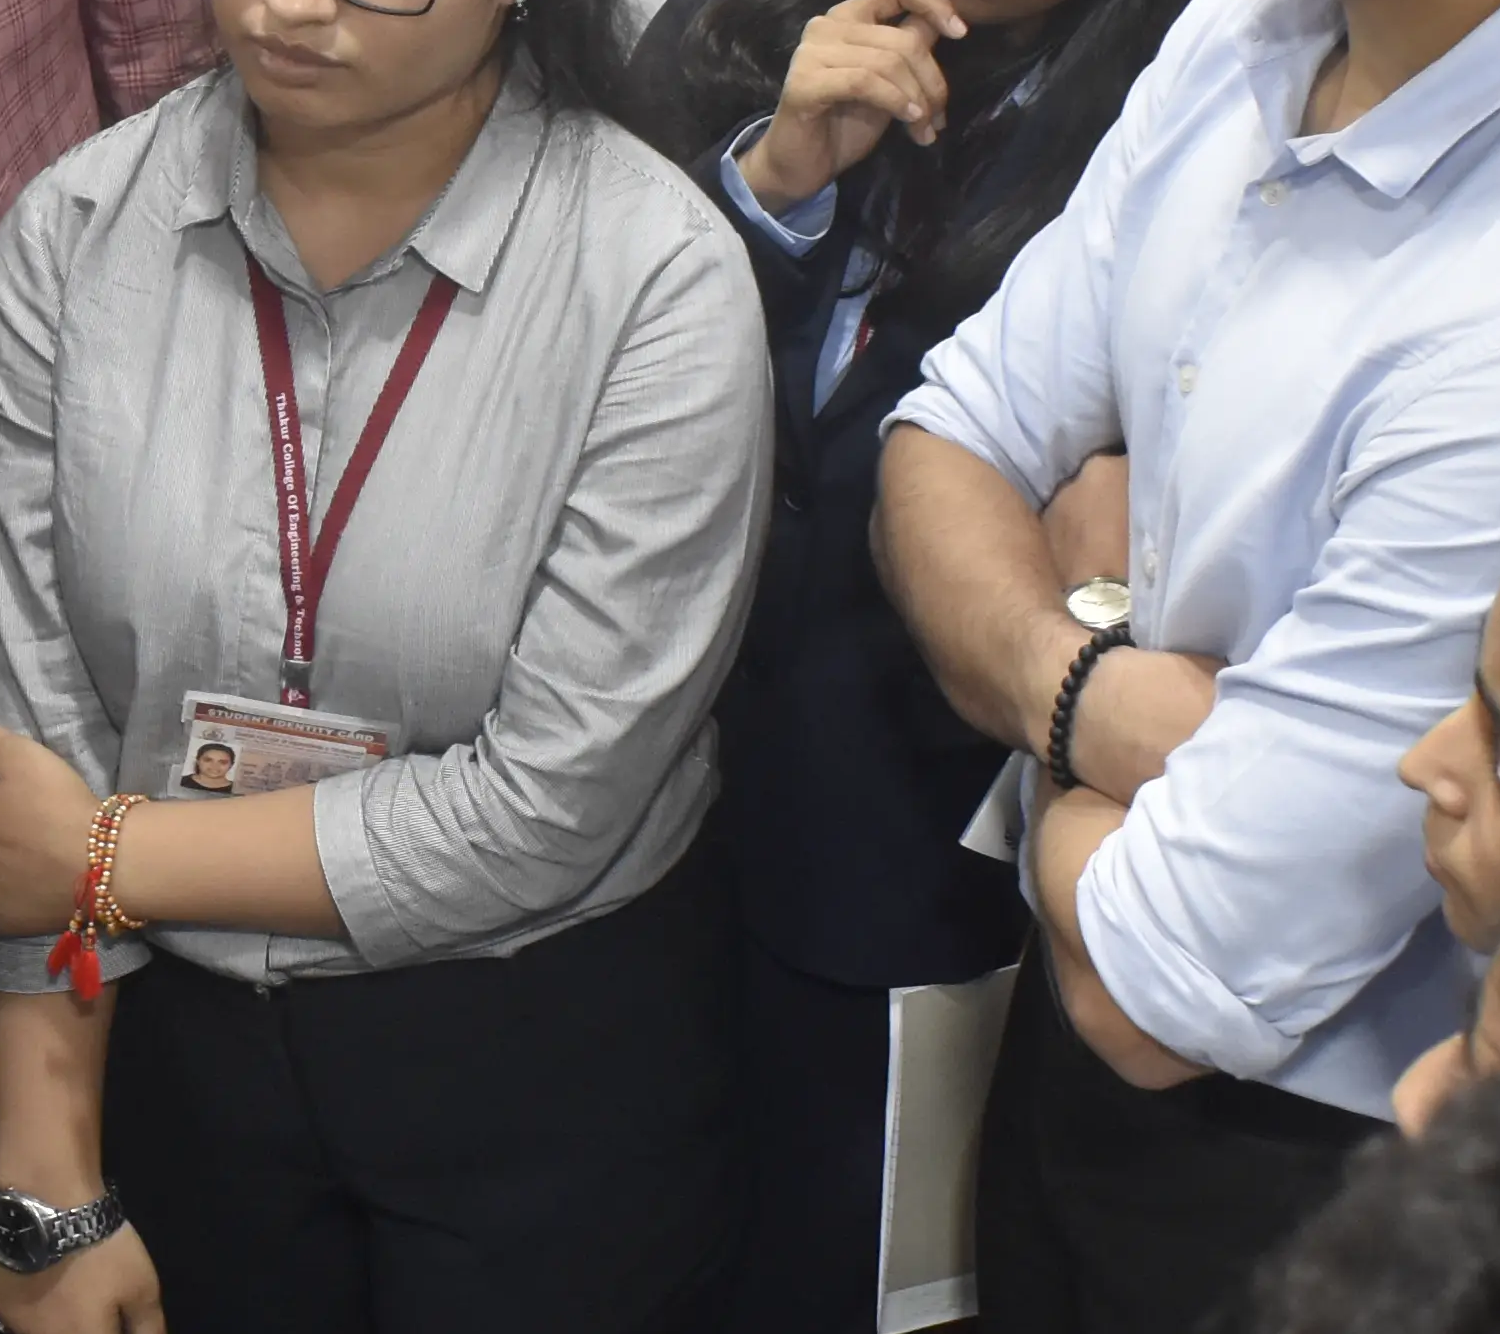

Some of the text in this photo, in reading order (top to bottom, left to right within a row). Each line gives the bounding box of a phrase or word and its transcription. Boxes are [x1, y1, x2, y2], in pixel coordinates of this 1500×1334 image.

[275, 392, 291, 440] Thakur
[282, 443, 296, 491] College
[287, 494, 299, 511] Of
[287, 514, 304, 591] Engineering
[293, 608, 306, 661] Technol
[207, 707, 375, 743] STUDENT IDENTITY CARD
